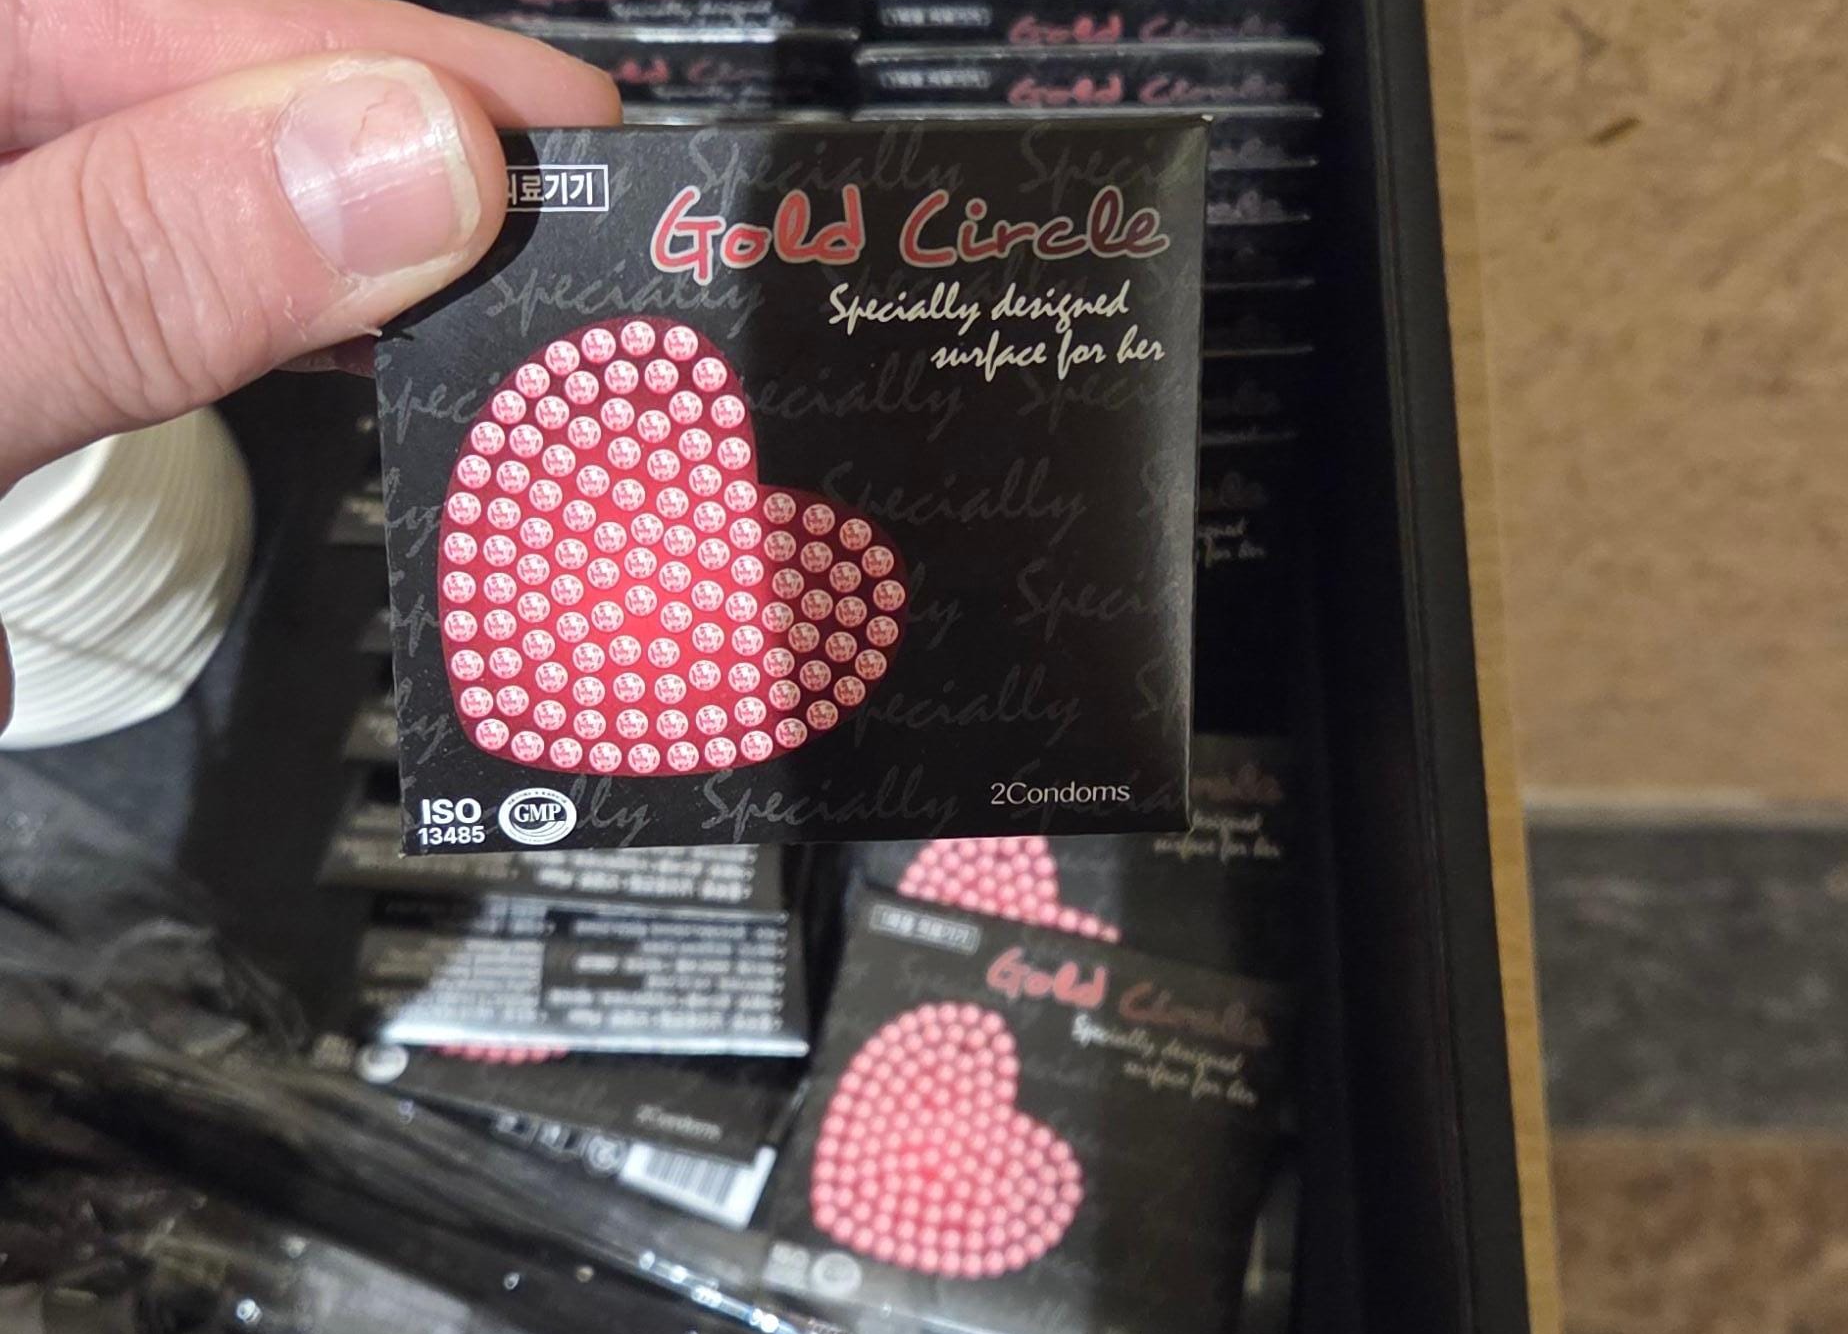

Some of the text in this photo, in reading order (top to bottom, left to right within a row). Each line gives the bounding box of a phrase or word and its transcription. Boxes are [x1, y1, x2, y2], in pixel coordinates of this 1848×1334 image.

[650, 184, 1170, 286] Gold Circle
[829, 278, 1131, 336] Specially designed
[930, 324, 1166, 383] surface for her
[990, 780, 1131, 806] 2Condoms
[422, 797, 483, 825] ISO
[514, 802, 562, 823] GMP
[418, 825, 486, 846] 13485
